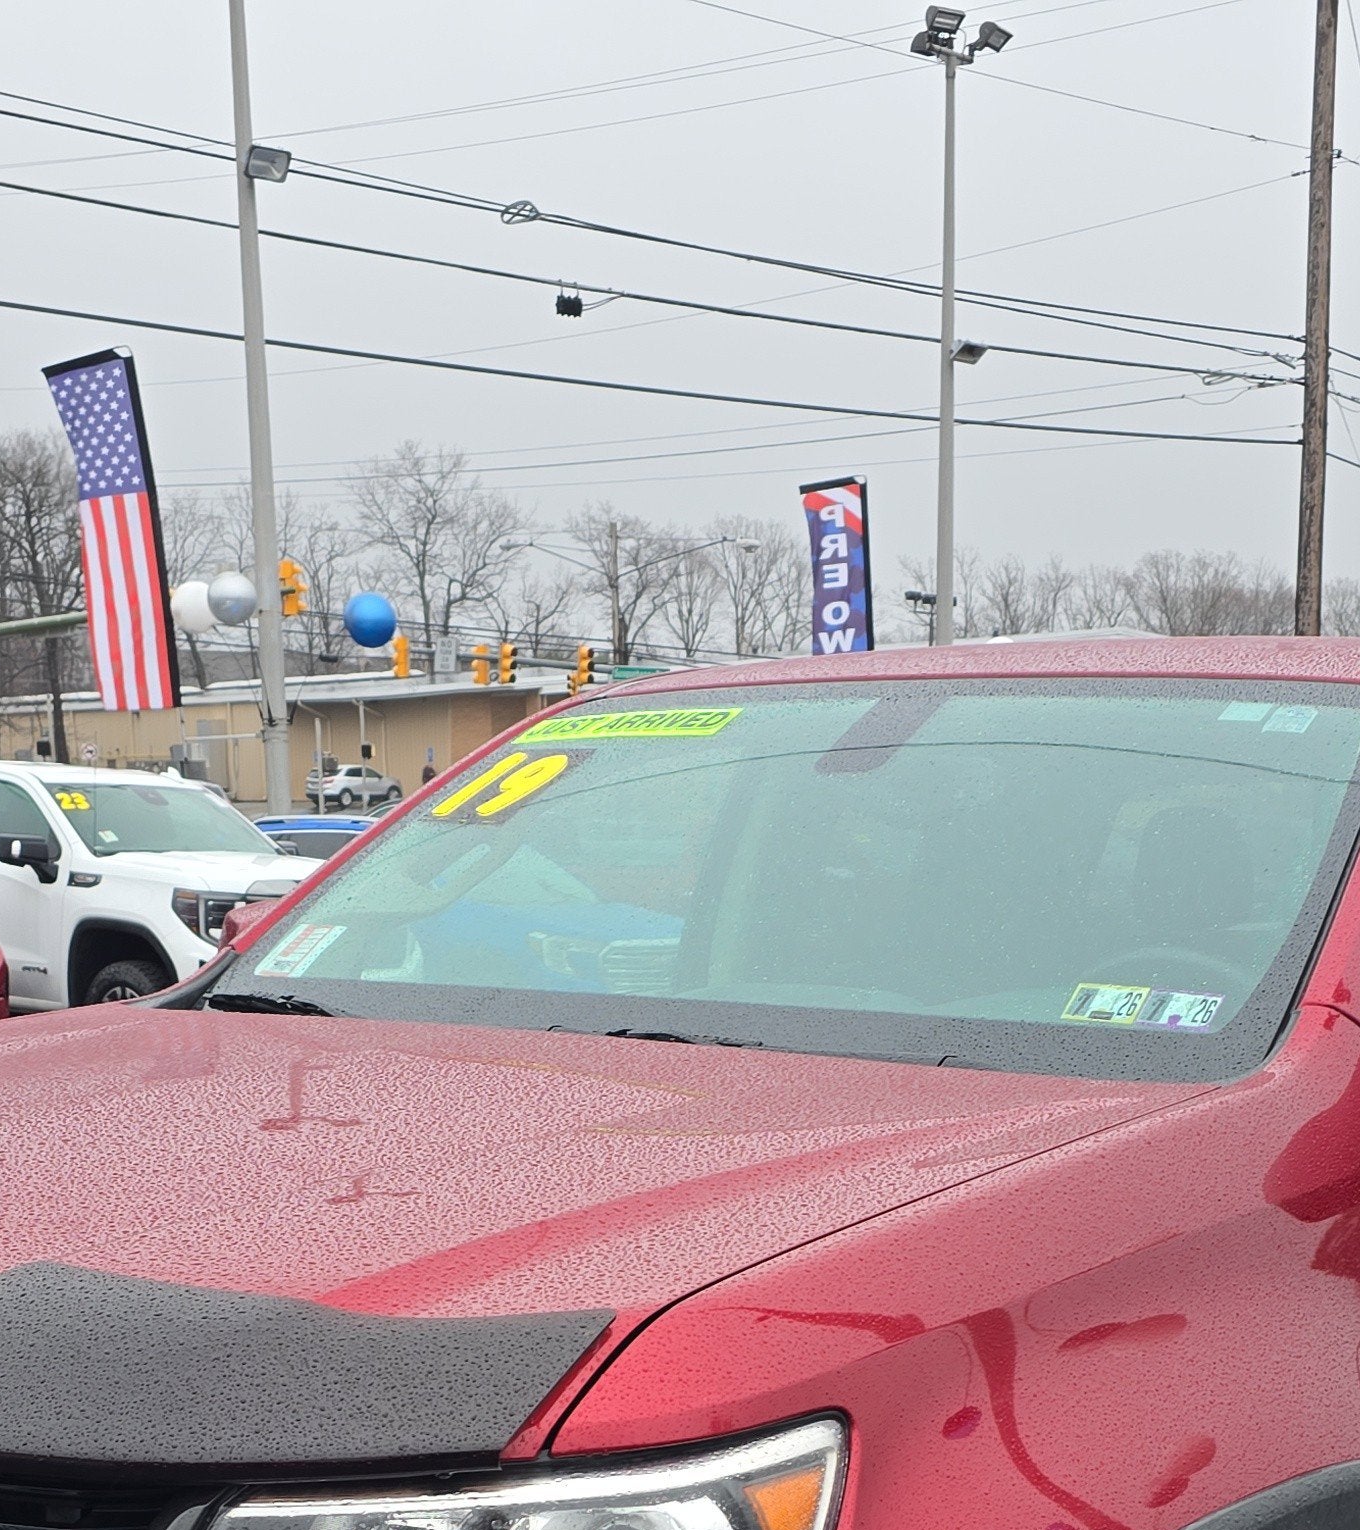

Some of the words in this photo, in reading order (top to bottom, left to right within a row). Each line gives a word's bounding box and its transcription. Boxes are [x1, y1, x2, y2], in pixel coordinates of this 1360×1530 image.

[528, 716, 604, 736] JUST
[597, 711, 731, 731] ARRIVED
[431, 752, 568, 817] 19
[55, 792, 91, 810] 23
[1116, 992, 1143, 1017] 26
[1191, 999, 1218, 1024] 26
